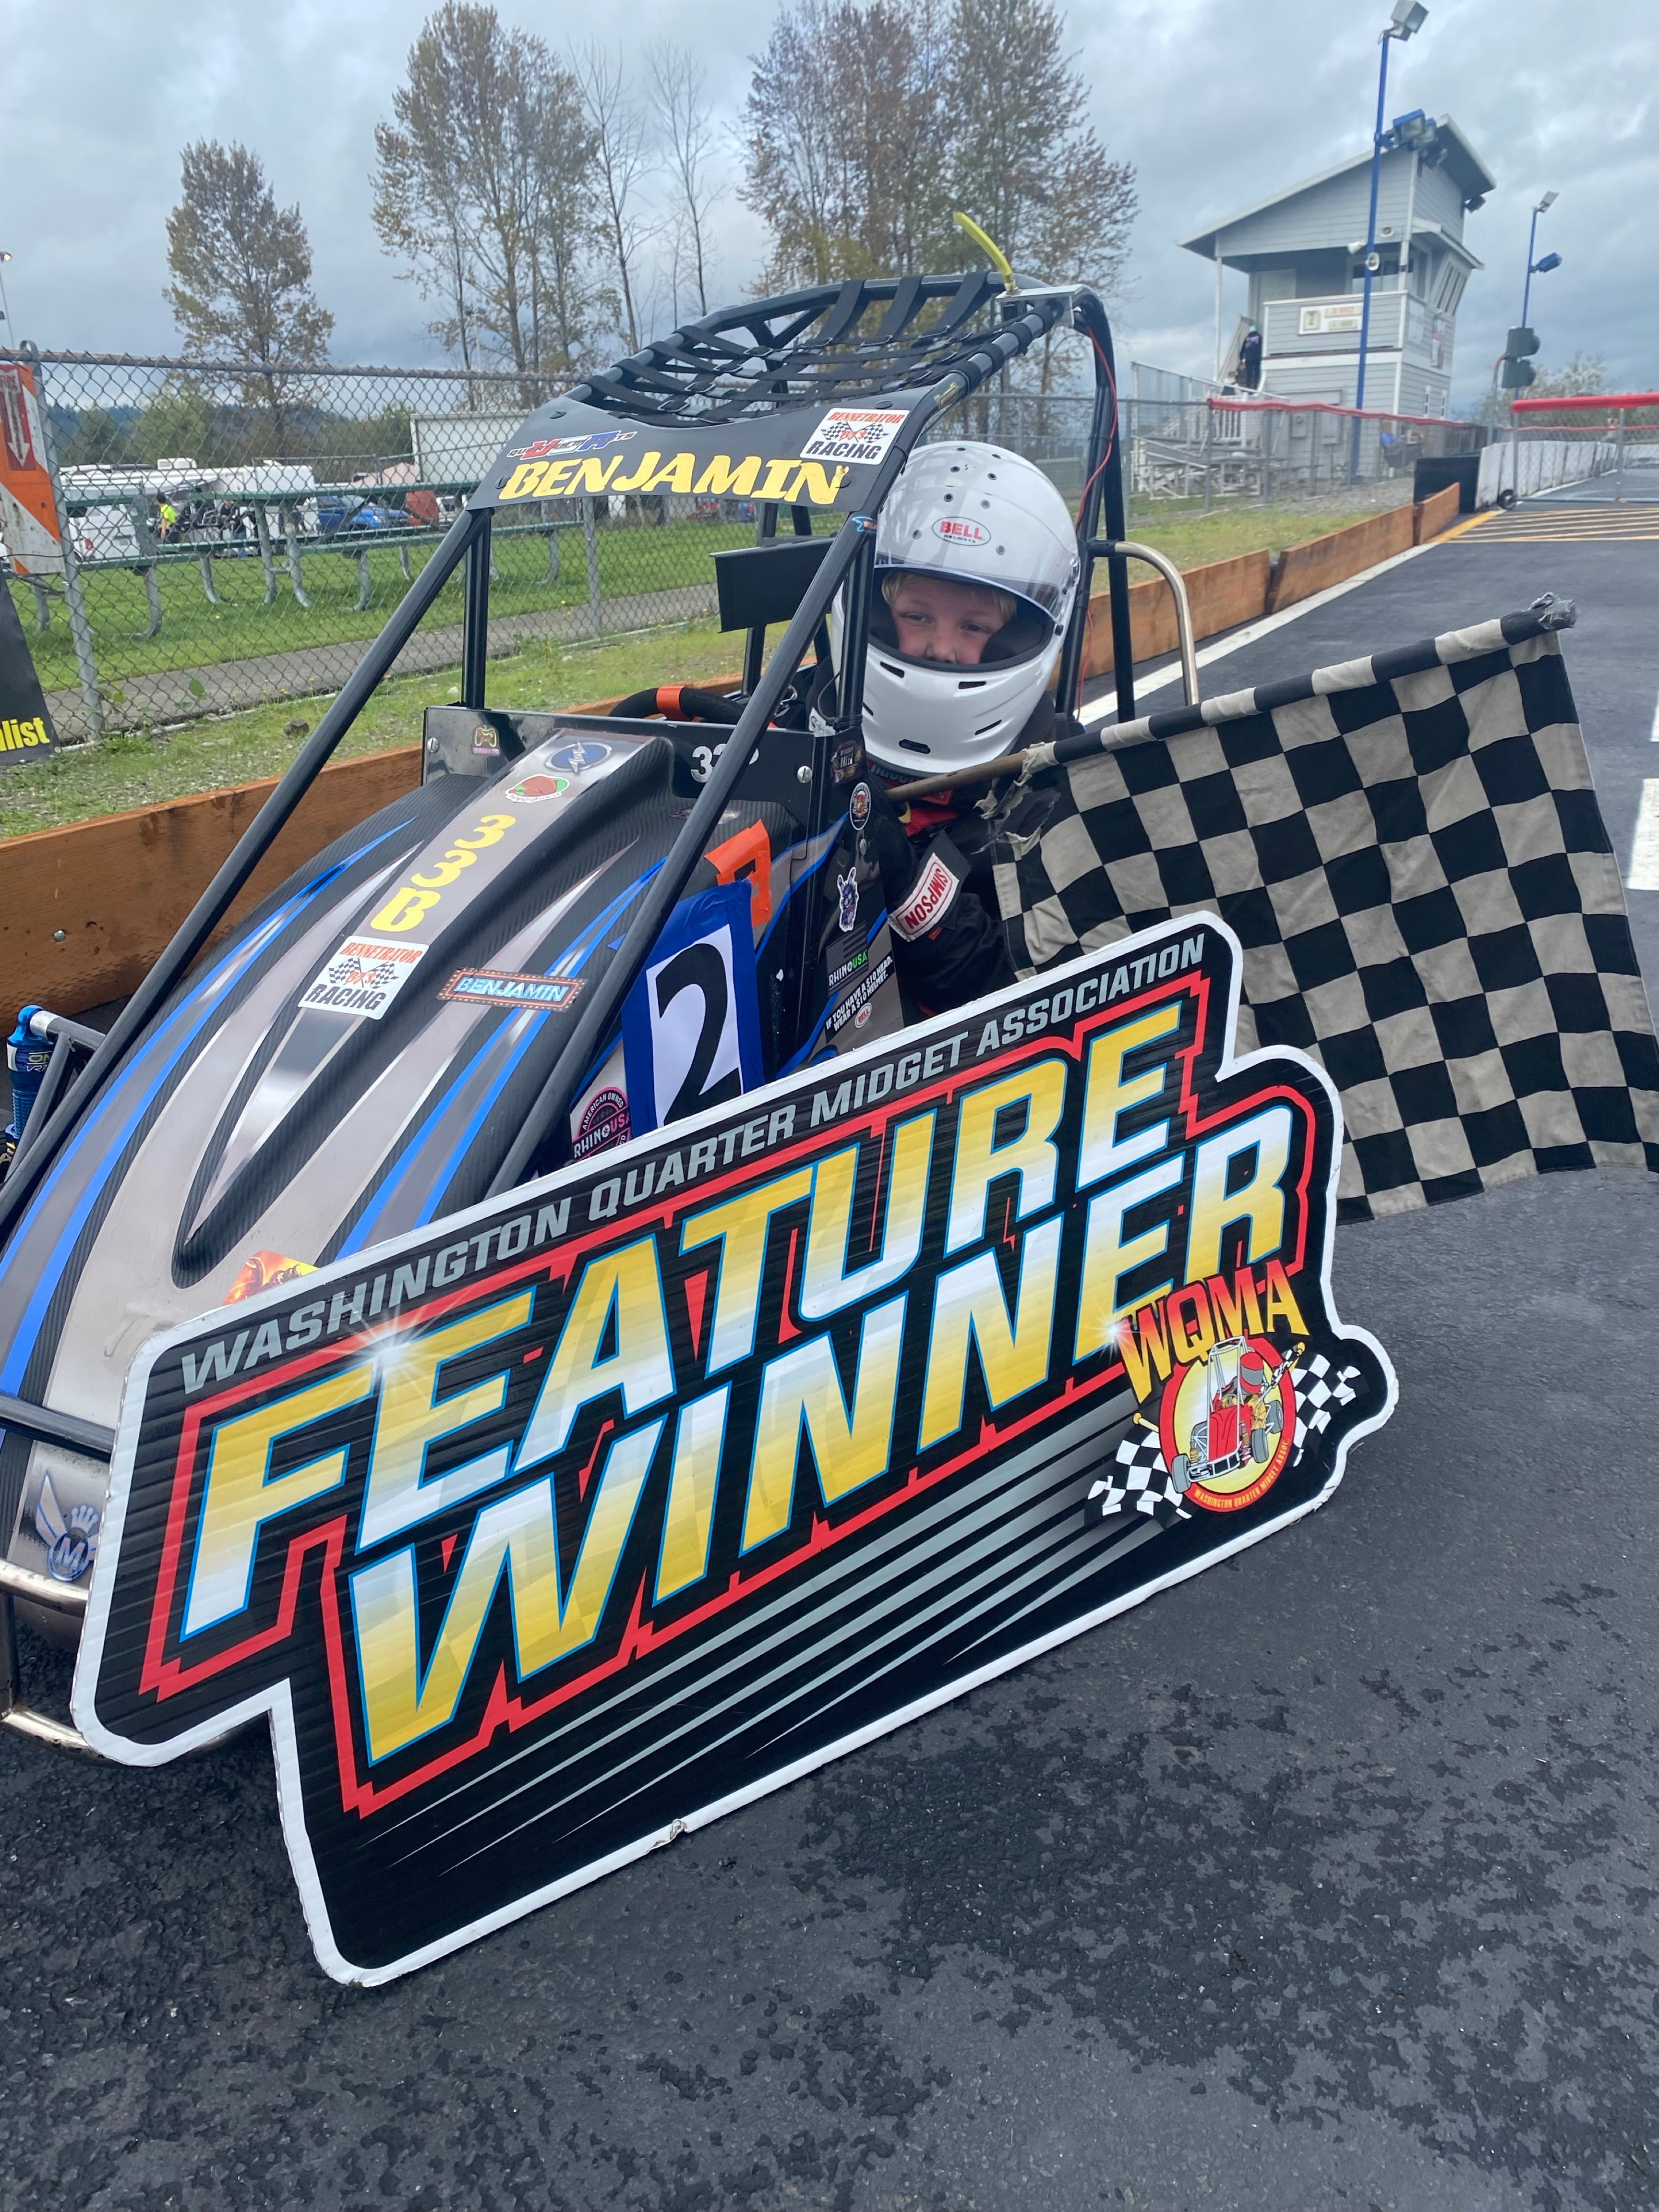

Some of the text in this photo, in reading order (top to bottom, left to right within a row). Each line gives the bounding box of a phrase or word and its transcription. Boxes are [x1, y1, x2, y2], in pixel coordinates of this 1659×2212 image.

[806, 441, 882, 459] RACING
[499, 452, 849, 505] BENJAMIN
[940, 521, 983, 540] BELL
[904, 868, 948, 929] SIMPSON
[339, 942, 423, 963] BENNETRATOR
[304, 984, 386, 1010] RACING
[454, 977, 569, 1002] BENJAMIN
[826, 1017, 832, 1030] IF
[832, 1005, 845, 1021] YOU
[845, 987, 861, 1010] HAVE
[861, 983, 866, 994] A
[656, 943, 741, 1126] 2
[834, 1010, 851, 1032] WEAR
[851, 1003, 856, 1014] A
[858, 1009, 869, 1023] BELL
[582, 1092, 624, 1130] AMERICAN OWNED
[181, 933, 1205, 1395] WASHINGTON QUARTER MIDGET ASSOCIATION
[180, 1000, 1182, 1642] FEATURE
[1117, 1259, 1310, 1404] WQMA
[349, 1106, 1292, 1767] WINNER
[1194, 1489, 1233, 1508] WASHINGTON
[1234, 1487, 1261, 1507] QUARTER
[1261, 1466, 1279, 1491] MIDGET
